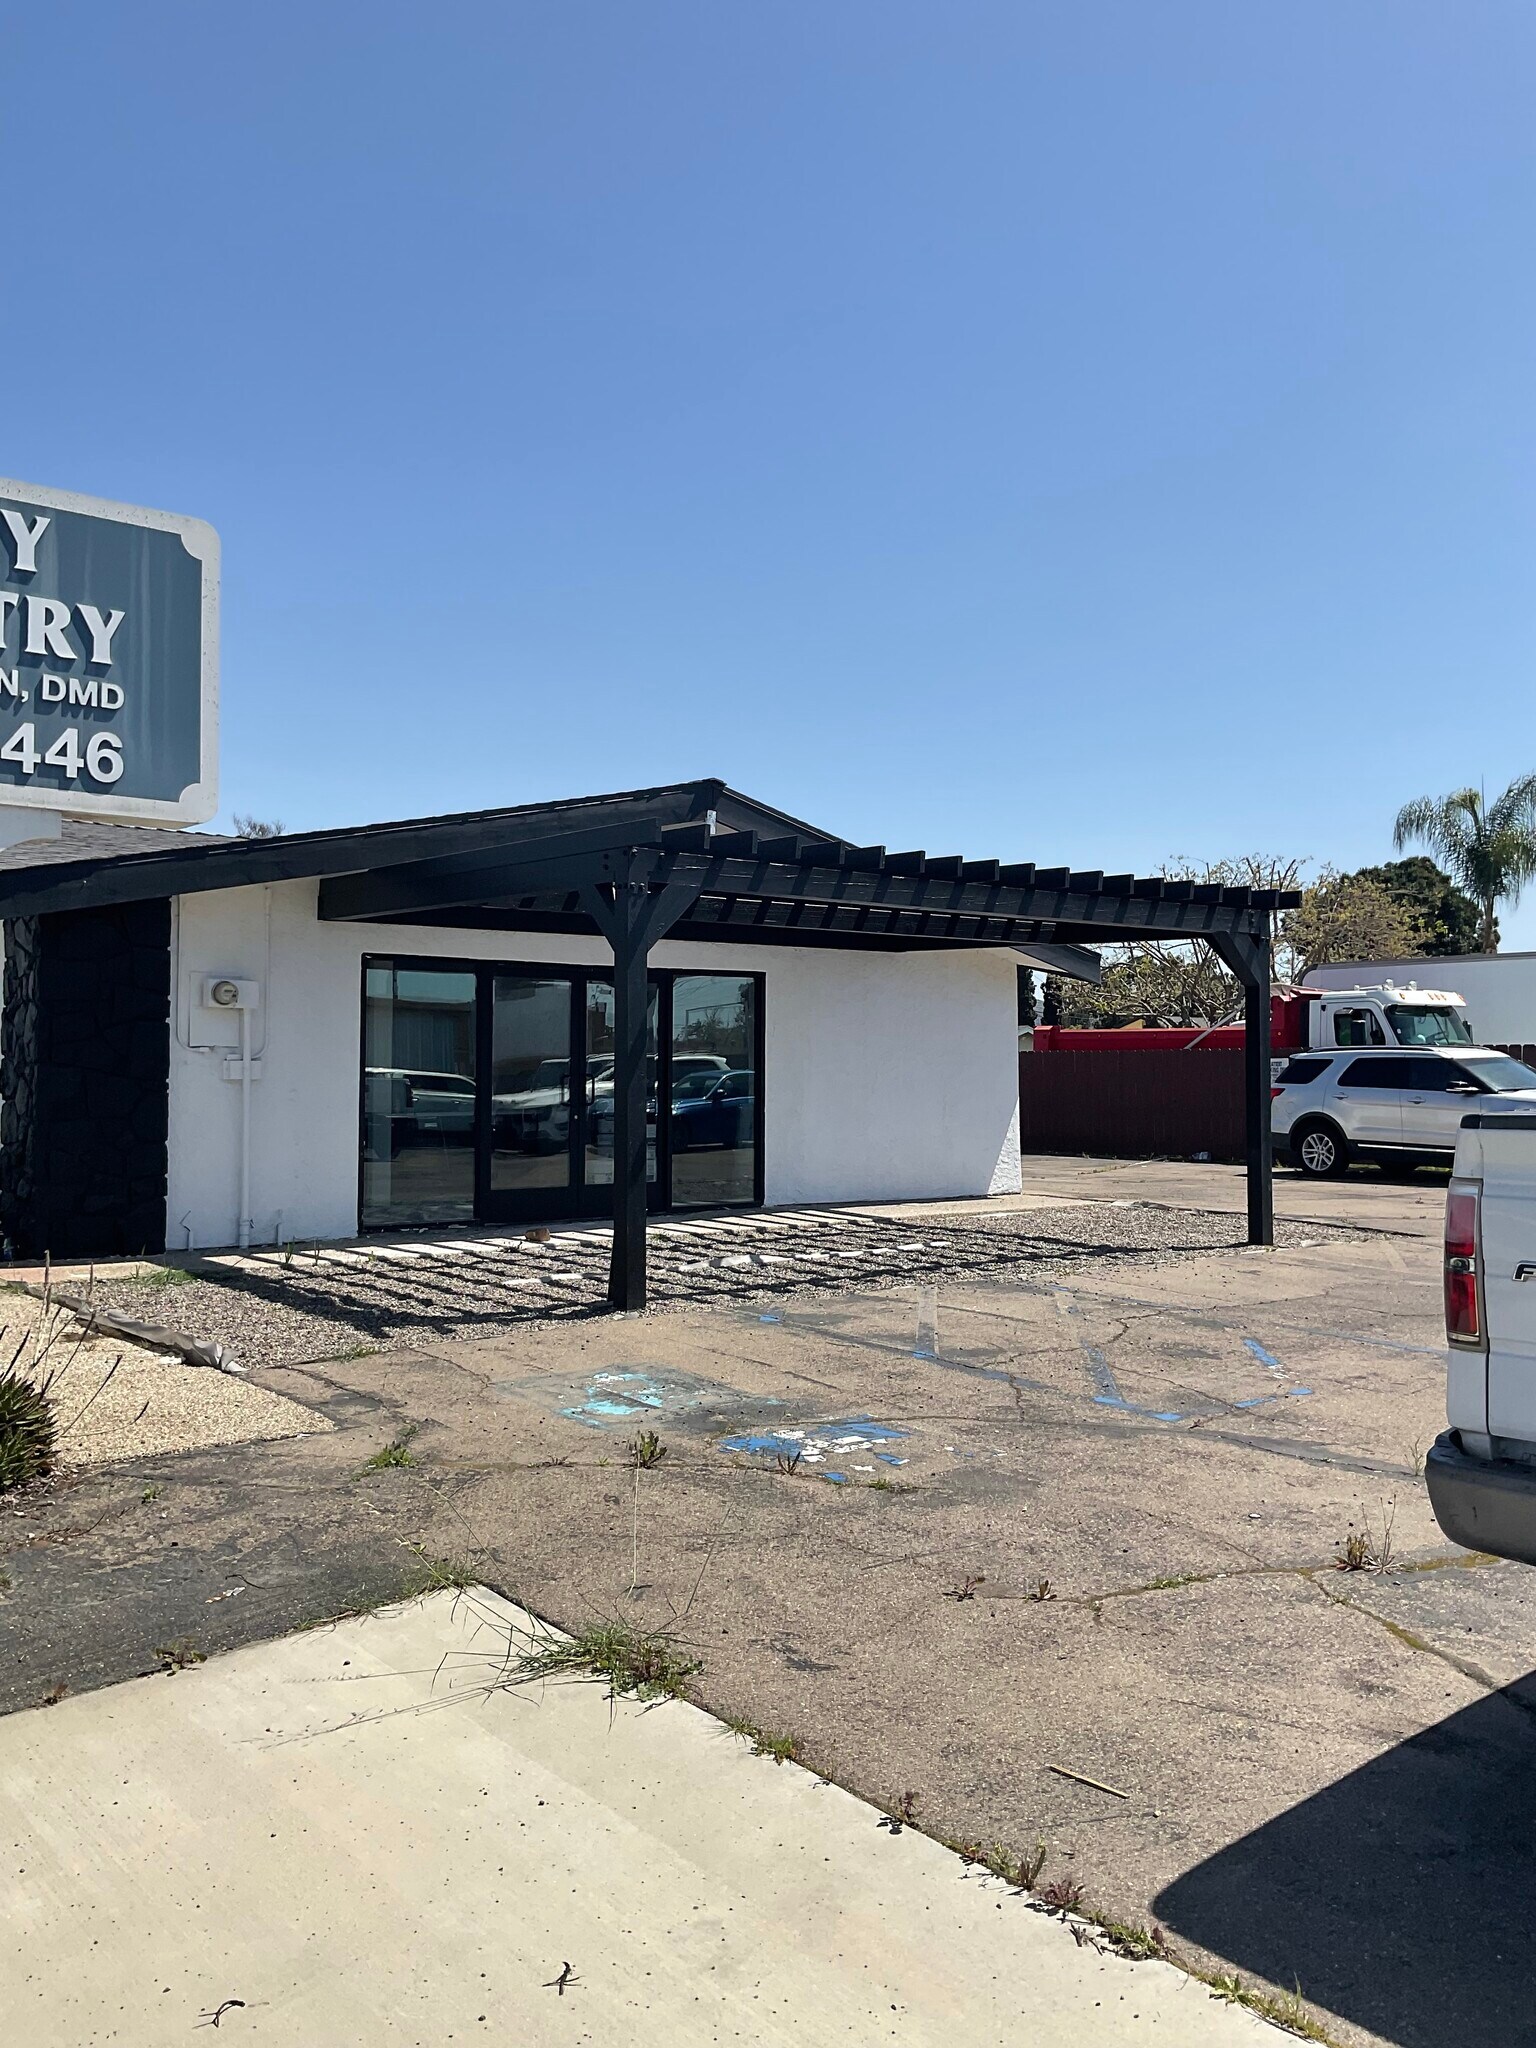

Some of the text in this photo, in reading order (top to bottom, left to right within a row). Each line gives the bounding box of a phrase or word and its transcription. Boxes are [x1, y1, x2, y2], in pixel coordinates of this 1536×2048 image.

[0, 509, 51, 572] Y
[42, 673, 125, 710] DMD
[1, 722, 124, 783] 446
